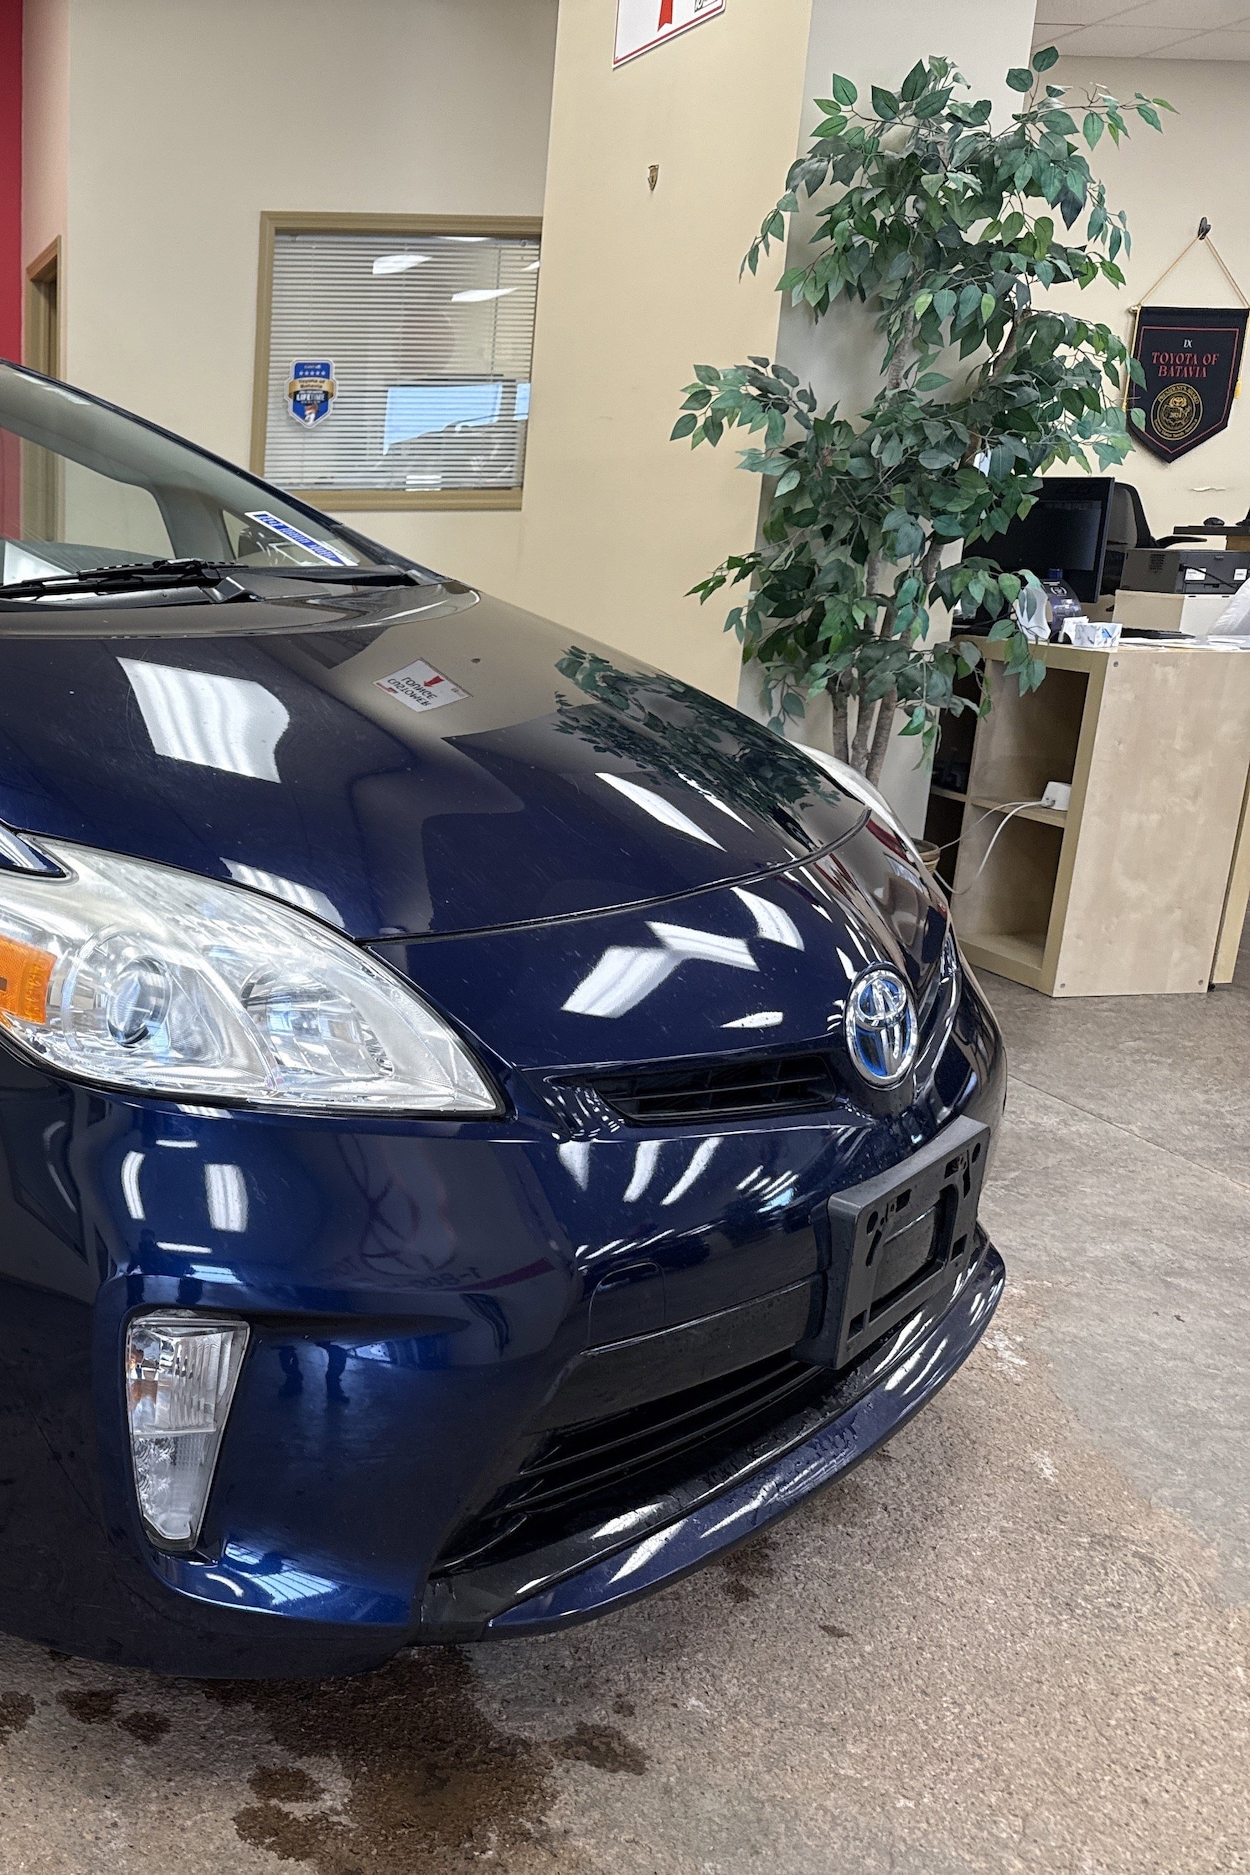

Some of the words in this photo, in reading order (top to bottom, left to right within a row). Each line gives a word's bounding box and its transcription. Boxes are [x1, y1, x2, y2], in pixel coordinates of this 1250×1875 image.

[1183, 339, 1193, 349] IX
[1151, 351, 1198, 365] TOYOTA
[1202, 352, 1220, 365] OF
[1158, 365, 1208, 378] BATAVIA
